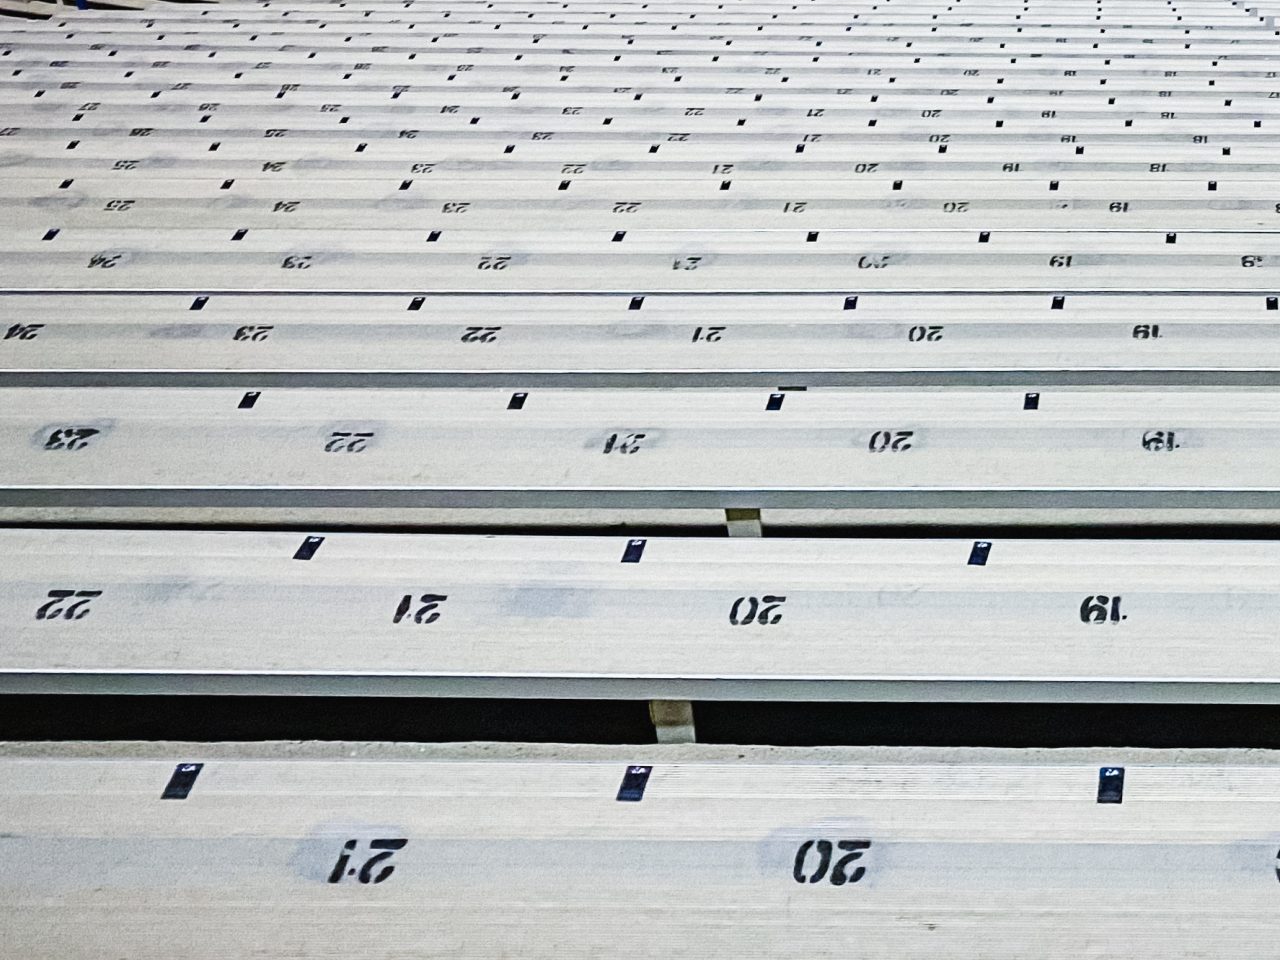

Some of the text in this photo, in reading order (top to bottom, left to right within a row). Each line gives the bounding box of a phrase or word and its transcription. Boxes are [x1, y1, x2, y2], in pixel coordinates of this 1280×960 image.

[113, 161, 140, 170] 25
[263, 162, 286, 171] 24
[411, 164, 436, 173] 23
[562, 164, 586, 173] 22
[713, 165, 733, 173] 21
[855, 163, 878, 172] 20
[1003, 163, 1019, 172] 19
[1150, 164, 1166, 172] 18
[104, 200, 135, 210] 25
[273, 201, 300, 212] 24
[443, 203, 470, 213] 23
[613, 202, 641, 212] 22
[784, 202, 807, 212] 21
[944, 202, 969, 212] 20
[1109, 202, 1128, 212] 19
[88, 255, 121, 268] 24
[282, 256, 312, 269] 23
[478, 257, 511, 270] 22
[1050, 256, 1072, 267] 19
[4, 324, 44, 339] 24
[233, 326, 274, 341] 23
[461, 327, 501, 342] 22
[693, 327, 726, 342] 21
[909, 326, 943, 341] 20
[1133, 325, 1159, 339] 19
[325, 432, 374, 452] 22
[604, 434, 645, 454] 21
[869, 431, 913, 450] 20
[1142, 431, 1180, 451] 19
[36, 590, 102, 620] 22
[393, 594, 447, 624] 21
[729, 596, 786, 625] 20
[1080, 595, 1131, 624] 19
[328, 839, 408, 884] 21
[793, 840, 871, 886] 20
